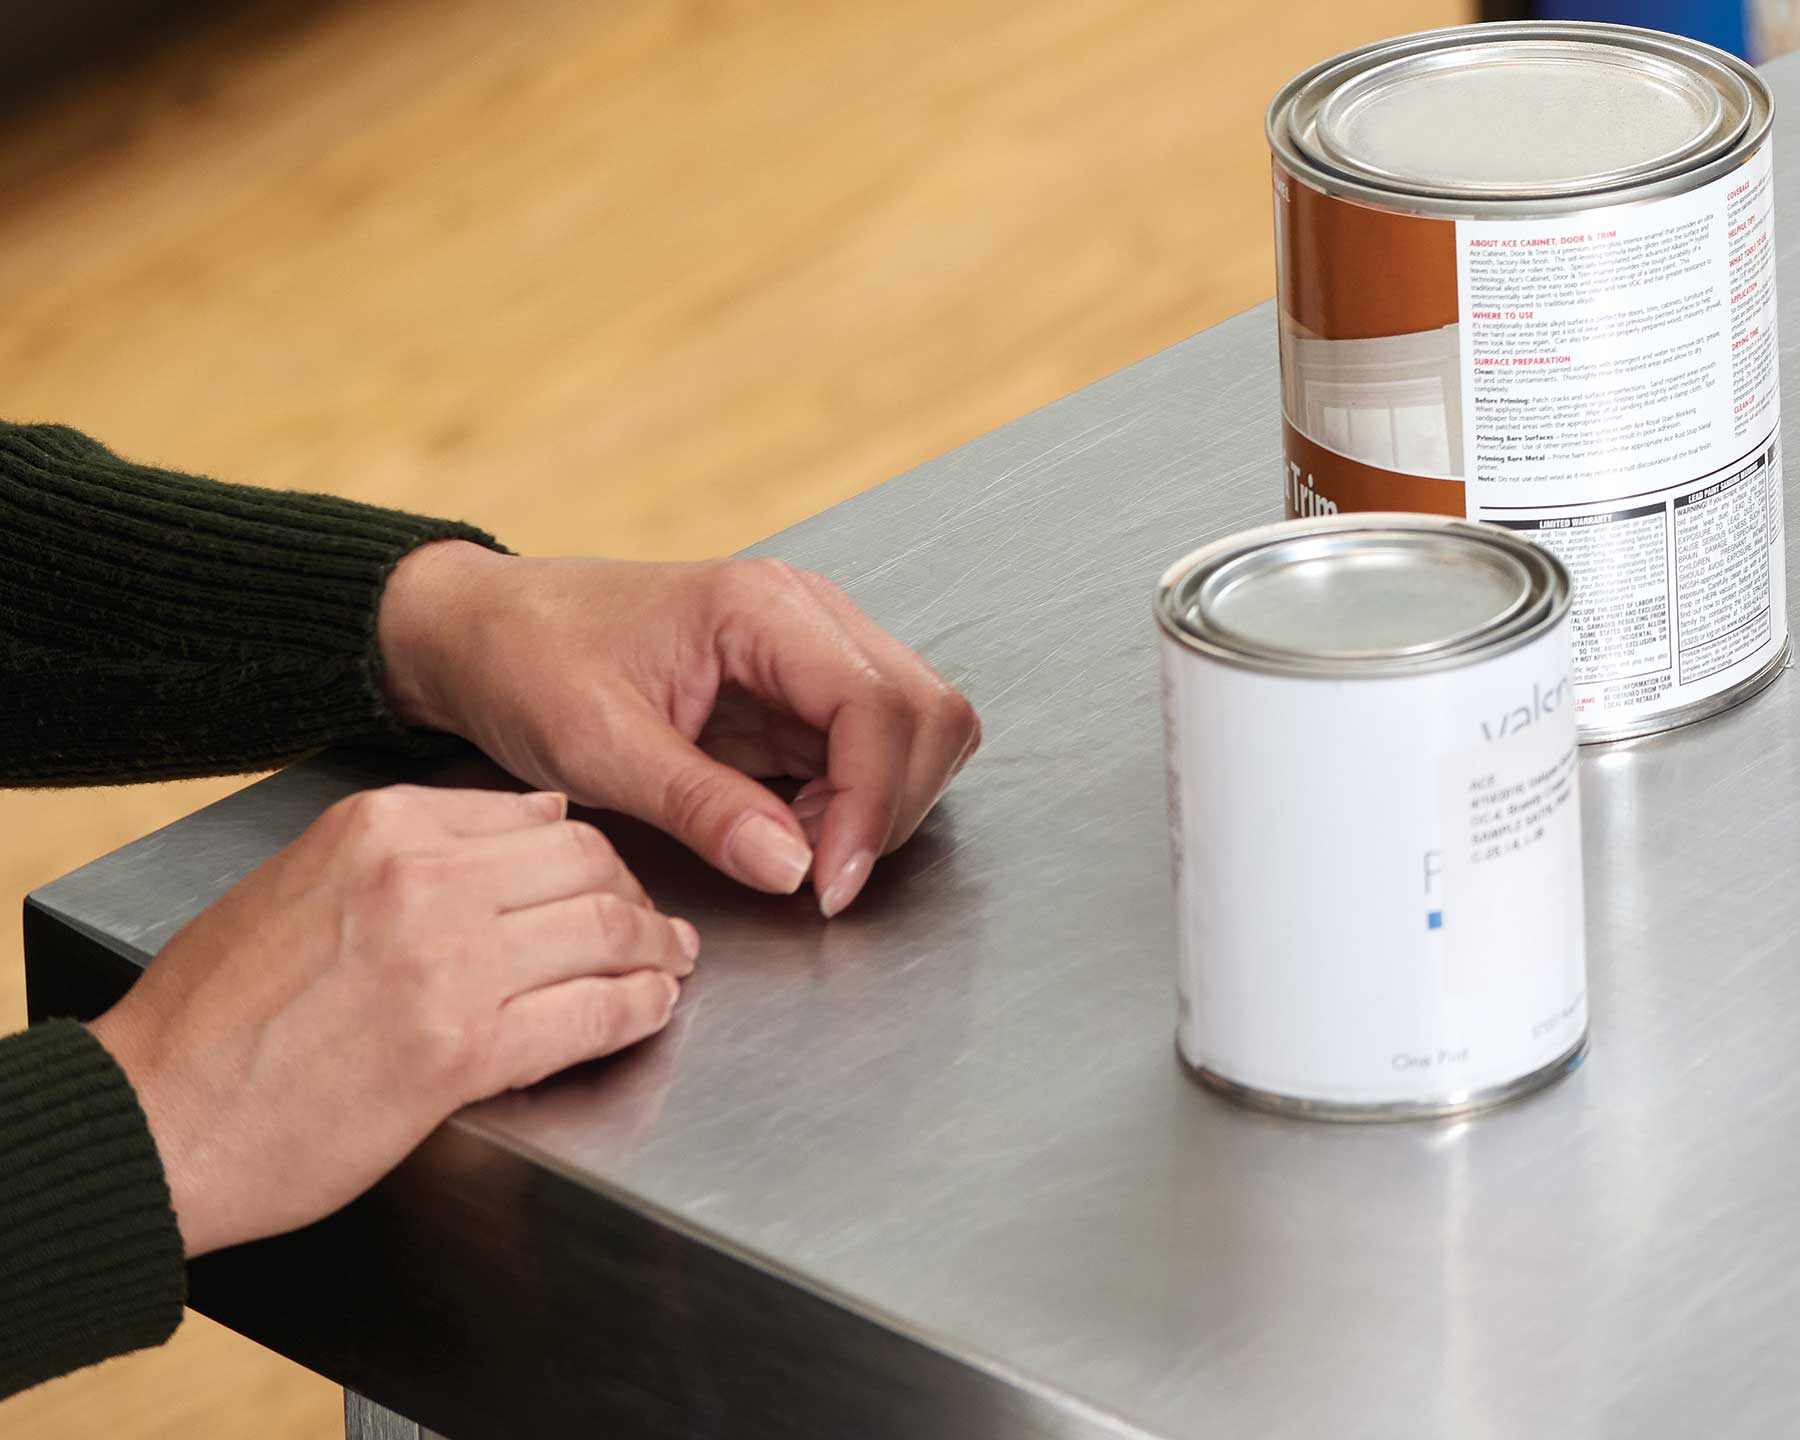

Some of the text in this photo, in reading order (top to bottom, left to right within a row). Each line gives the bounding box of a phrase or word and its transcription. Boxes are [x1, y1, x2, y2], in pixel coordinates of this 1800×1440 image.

[1469, 239, 1498, 247] ABOUT
[1519, 238, 1557, 246] CABINET,
[1559, 235, 1584, 244] DOOR
[1595, 230, 1616, 240] TRIM
[1512, 355, 1570, 364] PREPARATION
[1289, 460, 1338, 517] Trim
[1688, 491, 1703, 503] LEAD
[1676, 500, 1707, 517] WARNING!
[1538, 512, 1612, 529] LIMITED WARRANTY
[1677, 526, 1711, 545] EXPOSURE
[1727, 512, 1739, 526] LEAD
[1677, 540, 1698, 554] CAUSE
[1701, 529, 1725, 546] SERIOUS
[1720, 537, 1746, 557] PREGNANT
[1678, 550, 1697, 563] BRAIN
[1679, 566, 1704, 582] SHOULD
[1391, 1053, 1432, 1073] One
